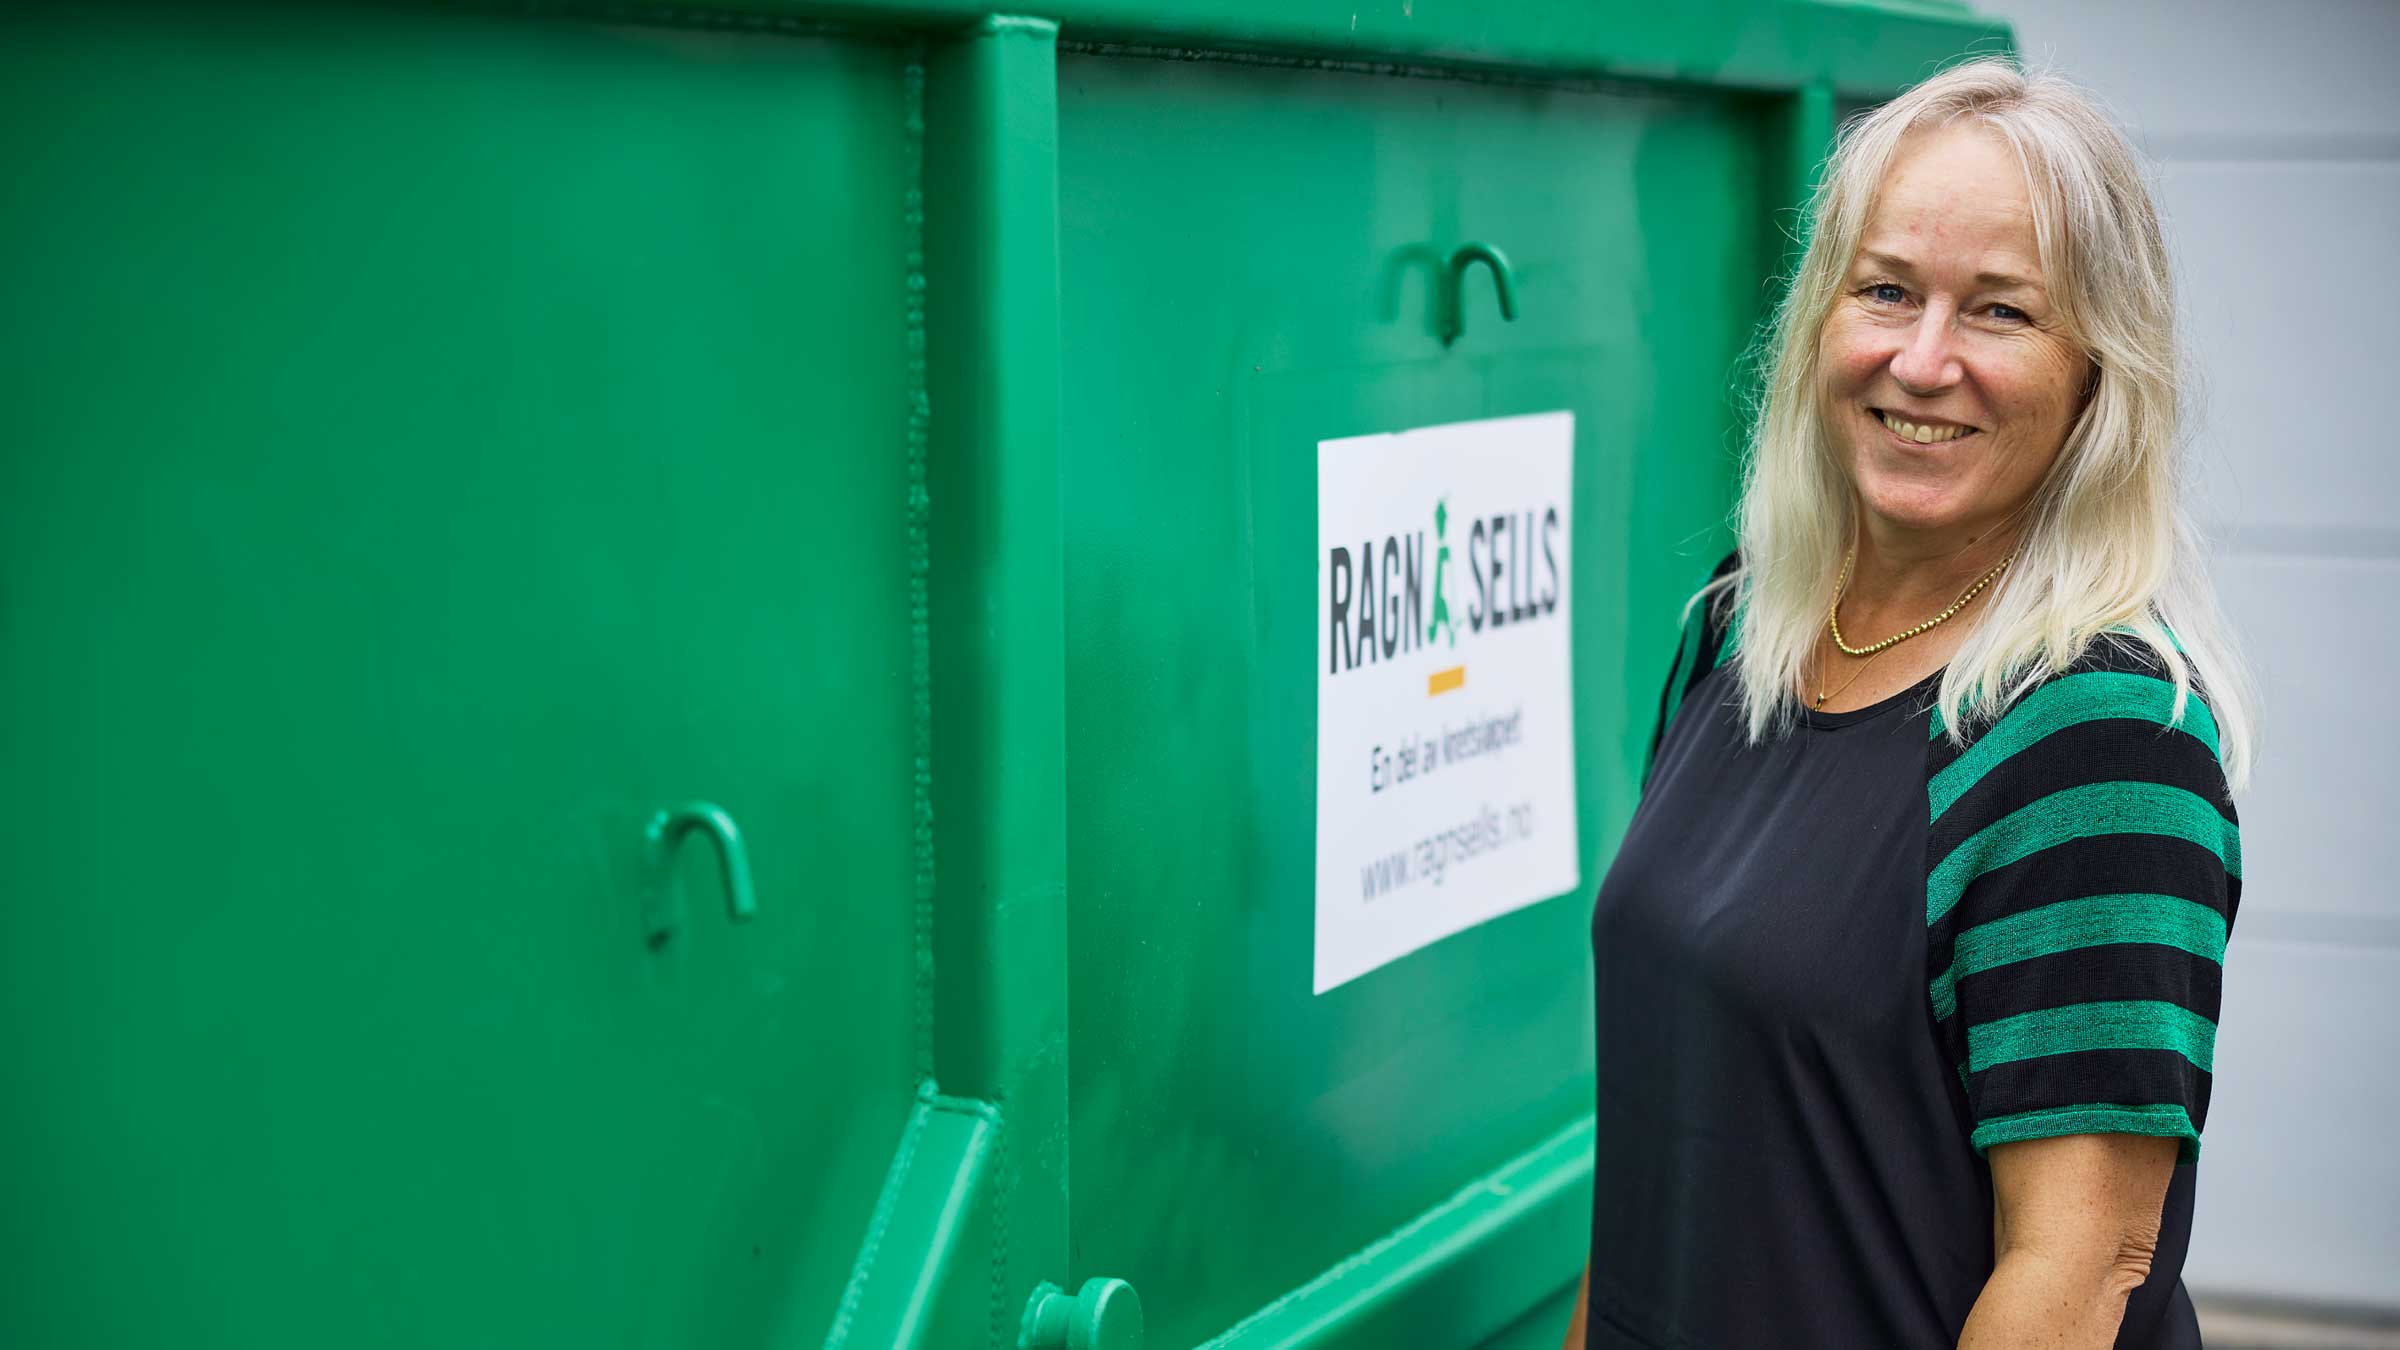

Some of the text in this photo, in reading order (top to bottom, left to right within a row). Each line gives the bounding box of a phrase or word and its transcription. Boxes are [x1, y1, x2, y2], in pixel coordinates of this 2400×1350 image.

[1330, 507, 1560, 675] RAGN SELLS
[1371, 745, 1391, 793] En
[1396, 731, 1417, 784] del
[1422, 740, 1439, 774] av
[1360, 802, 1533, 903] www.ragnsells.no
